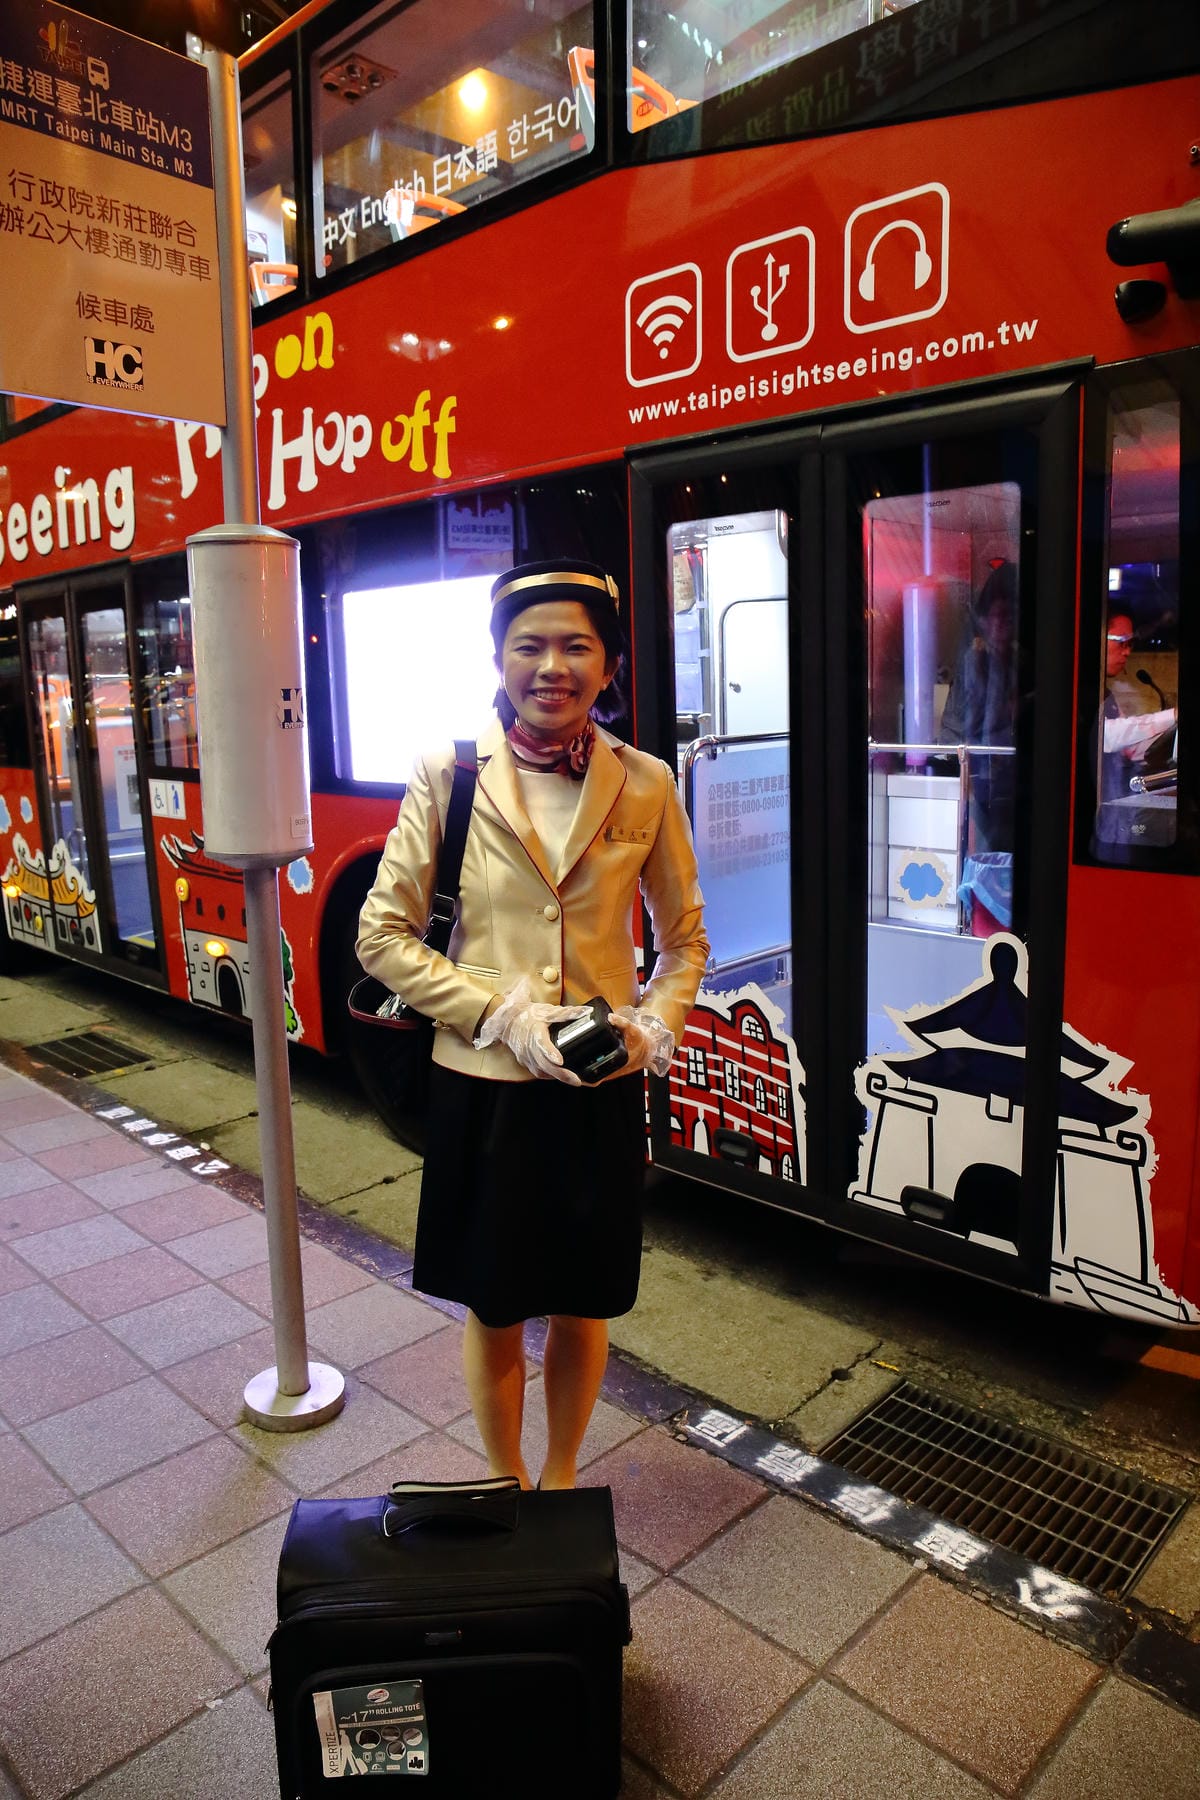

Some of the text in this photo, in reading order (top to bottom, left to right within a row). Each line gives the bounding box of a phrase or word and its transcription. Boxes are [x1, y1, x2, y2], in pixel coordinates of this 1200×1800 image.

[1, 98, 193, 178] MRT Taipei Main Sta. M3
[322, 88, 581, 251] 中文 English 日本語 한국어
[0, 201, 212, 282] 辦公大樓通勤專車
[8, 169, 198, 248] 行政院新莊聯合
[75, 290, 156, 334] 候車處
[275, 311, 334, 379] on
[85, 337, 143, 384] HC
[96, 377, 145, 392] EVERYWHERE
[629, 318, 1039, 424] www.taipeisightseeing.com.tw
[267, 407, 373, 510] Hop
[381, 389, 457, 479] off
[0, 464, 136, 566] eeing
[376, 1705, 404, 1716] ROLLING
[404, 1701, 421, 1712] TOTE
[326, 1731, 340, 1775] XPERTIZE
